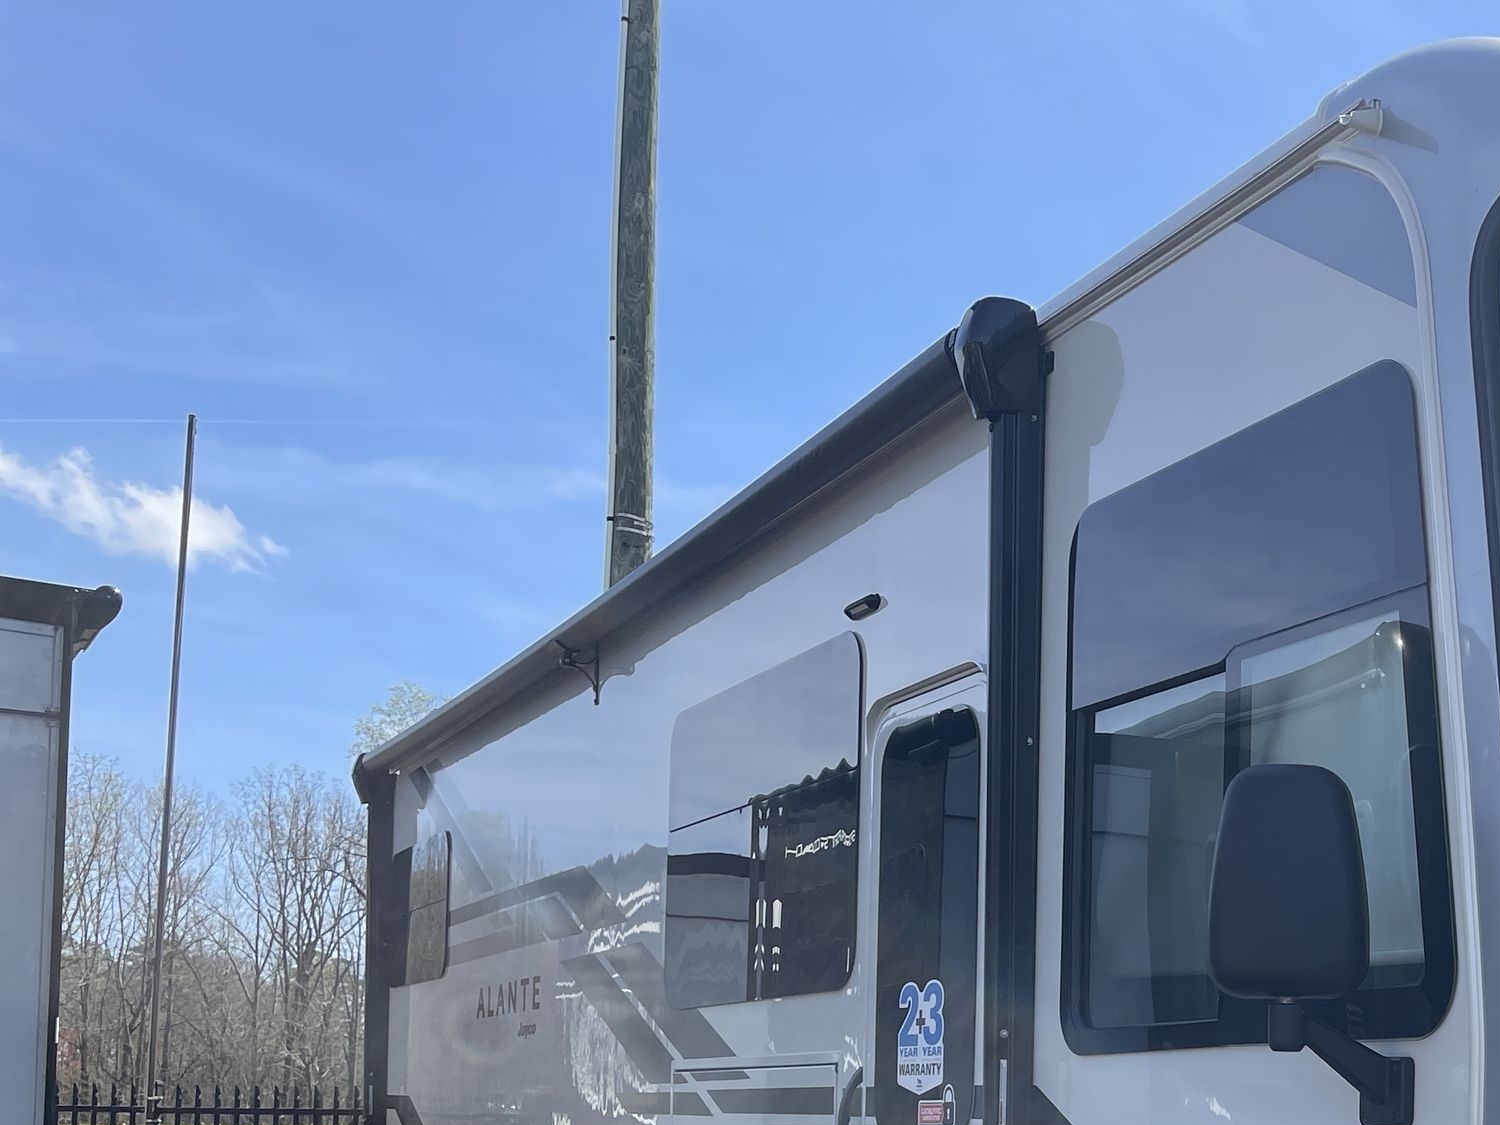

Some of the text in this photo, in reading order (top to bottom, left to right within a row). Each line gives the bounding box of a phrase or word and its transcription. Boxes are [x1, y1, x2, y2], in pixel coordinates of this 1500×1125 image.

[476, 975, 541, 1019] ALANTE
[899, 1046, 942, 1057] YEAR YEAR
[899, 1063, 941, 1076] WARRANTY
